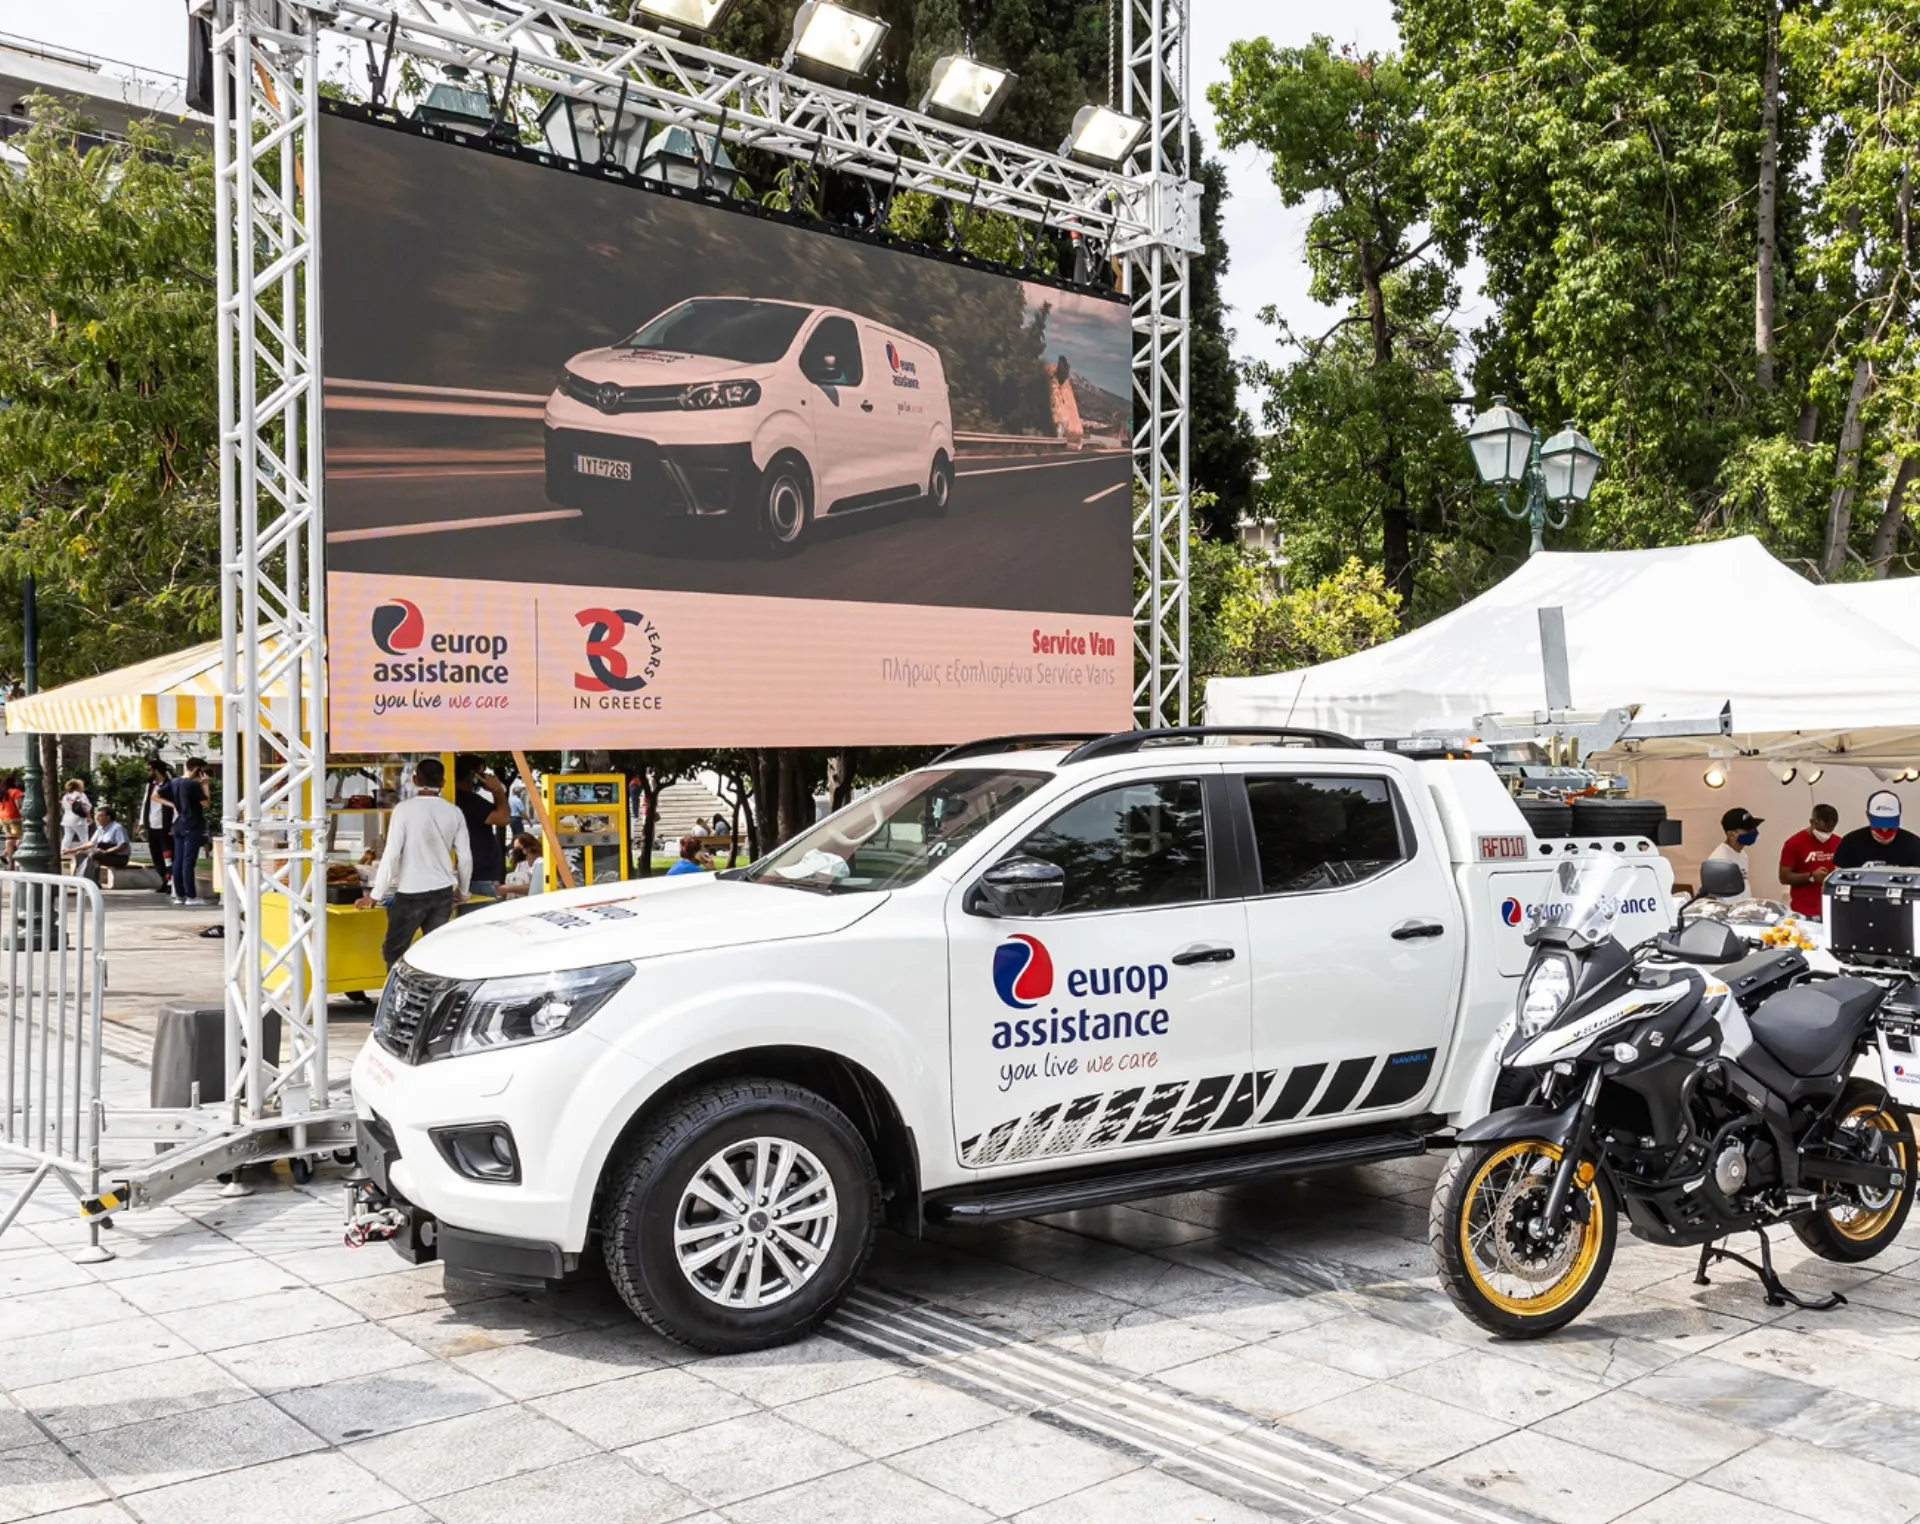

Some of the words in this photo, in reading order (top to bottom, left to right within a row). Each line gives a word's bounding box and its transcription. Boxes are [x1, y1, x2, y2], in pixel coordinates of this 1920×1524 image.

[430, 633, 508, 659] europ
[643, 621, 662, 679] YEARS
[1032, 629, 1086, 656] Service
[1089, 632, 1116, 656] Van
[373, 657, 509, 684] assistance
[882, 658, 942, 688] Πλήρως
[945, 659, 1033, 688] εξοπλισμένα
[1036, 663, 1083, 685] Service
[1086, 664, 1116, 685] Vans
[373, 693, 407, 716] you
[412, 688, 443, 708] live
[449, 693, 473, 709] we
[475, 693, 509, 709] care
[574, 696, 591, 710] IN
[599, 696, 662, 711] GREECE
[1067, 964, 1169, 999] europ
[991, 1007, 1170, 1050] assistance
[998, 1063, 1039, 1092] you
[1044, 1052, 1080, 1077] live
[1086, 1055, 1114, 1073] we
[1118, 1051, 1158, 1071] care
[1391, 1053, 1429, 1064] NAVARA
